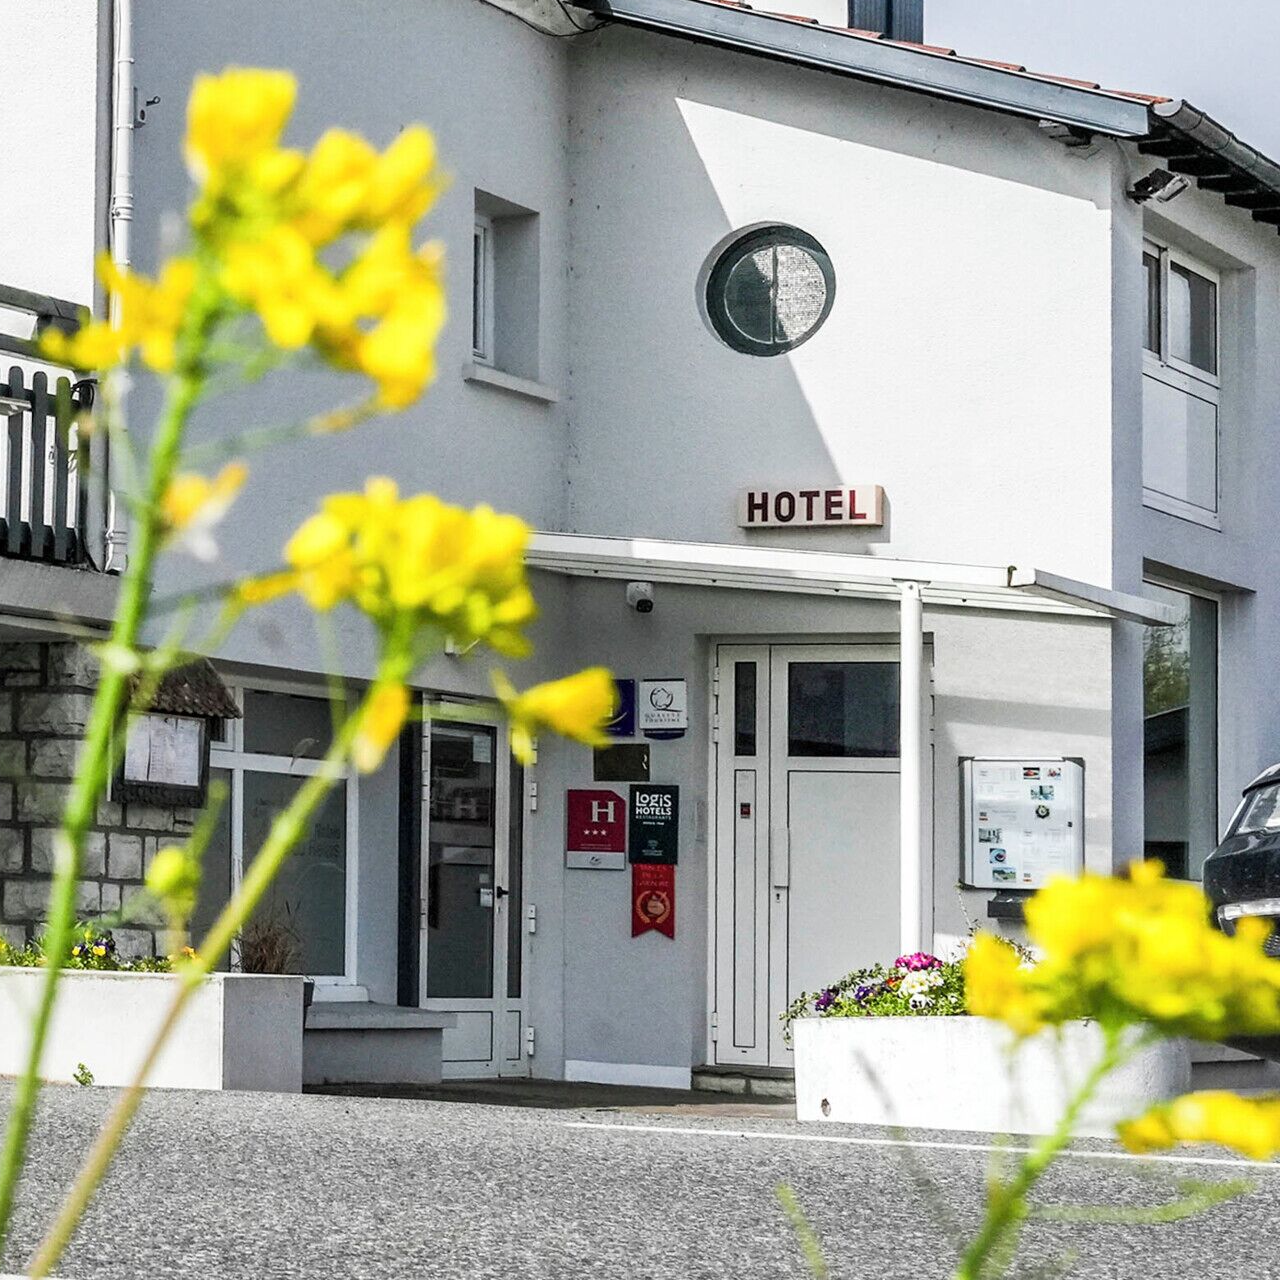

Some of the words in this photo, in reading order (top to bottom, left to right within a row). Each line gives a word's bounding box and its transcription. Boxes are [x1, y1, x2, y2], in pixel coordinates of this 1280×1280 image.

[747, 489, 867, 523] HOTEL
[592, 800, 616, 823] H
[635, 807, 672, 816] HOTELS
